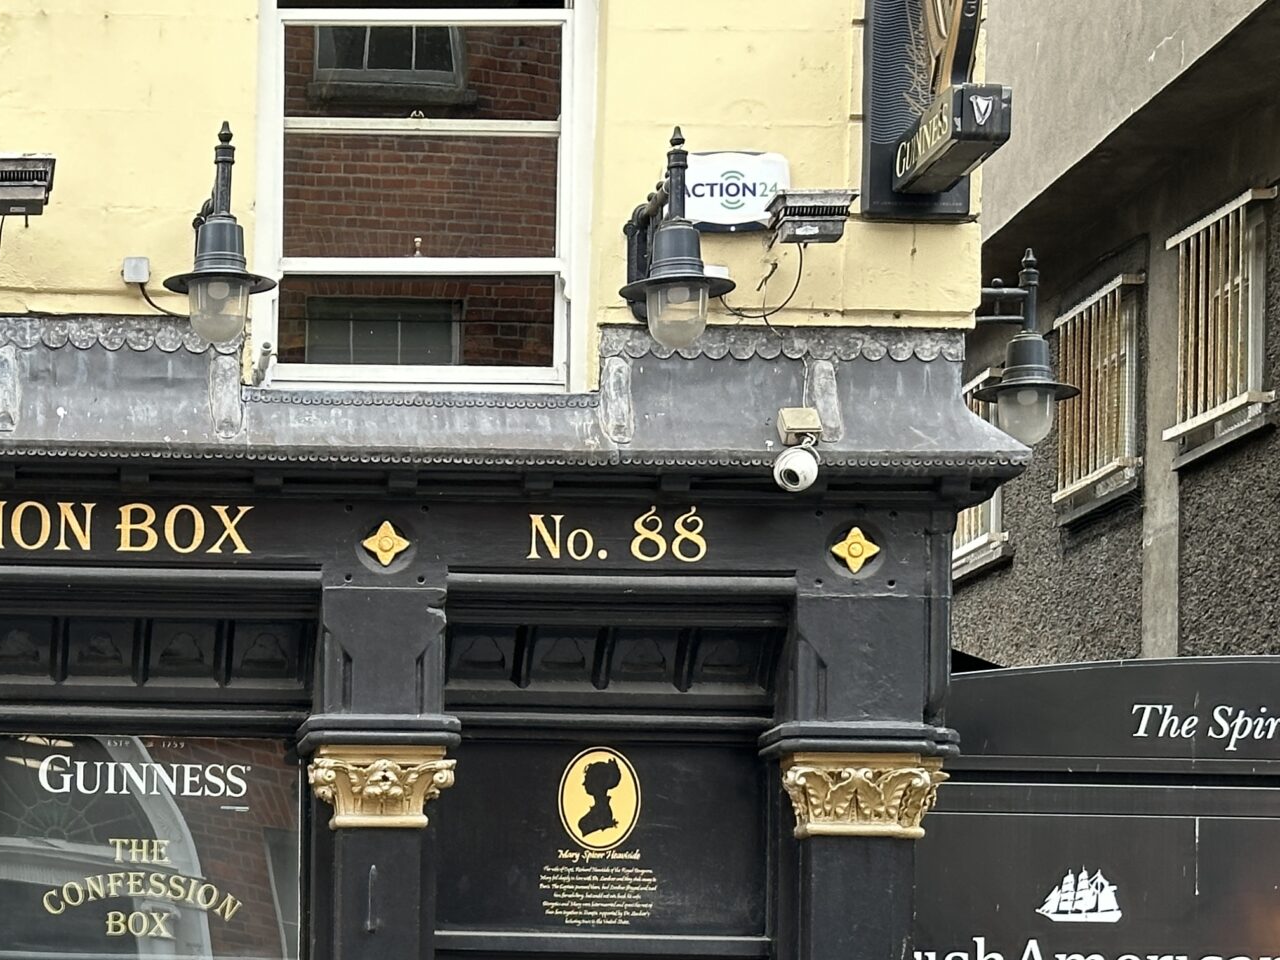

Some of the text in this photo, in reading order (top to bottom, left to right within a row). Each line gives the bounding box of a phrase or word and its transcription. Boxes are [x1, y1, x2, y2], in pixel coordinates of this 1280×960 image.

[116, 503, 254, 554] BOX
[526, 505, 707, 562] No. 88
[1131, 704, 1199, 738] The
[38, 754, 248, 798] GUINNESS
[109, 838, 171, 864] THE
[558, 849, 580, 863] Mary
[42, 872, 243, 922] CONFESSION
[106, 910, 176, 940] BOX
